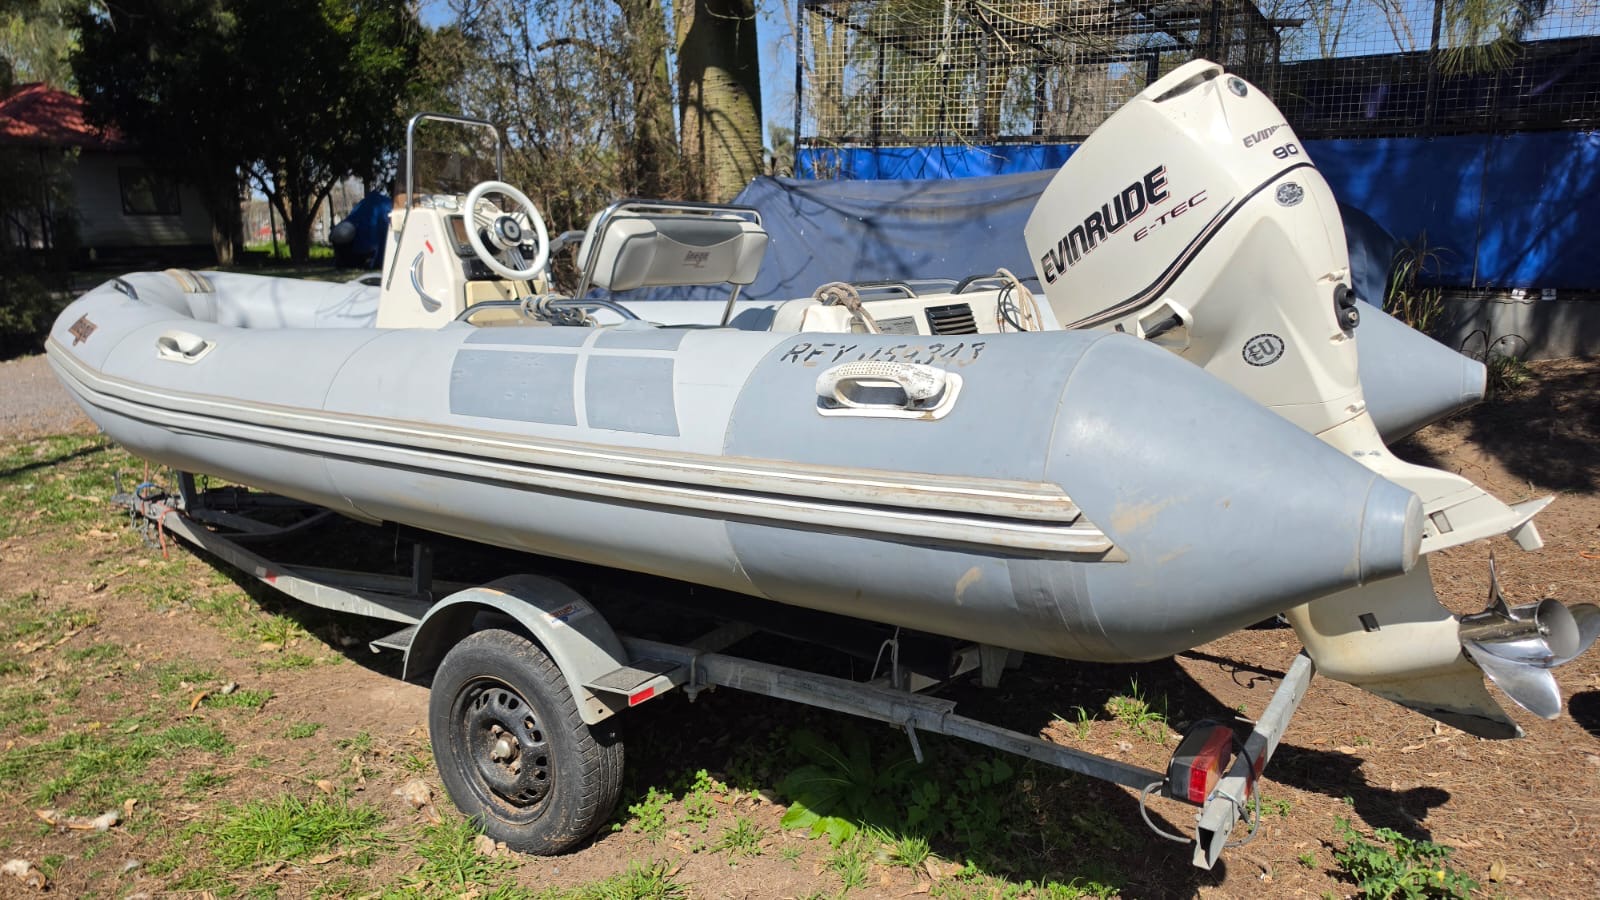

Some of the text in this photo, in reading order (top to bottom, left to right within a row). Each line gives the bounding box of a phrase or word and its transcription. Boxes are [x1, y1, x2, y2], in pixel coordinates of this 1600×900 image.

[1272, 143, 1299, 159] 90
[1041, 164, 1170, 284] EVINRUDE
[1133, 189, 1208, 242] E-TEC
[1248, 338, 1275, 361] EU
